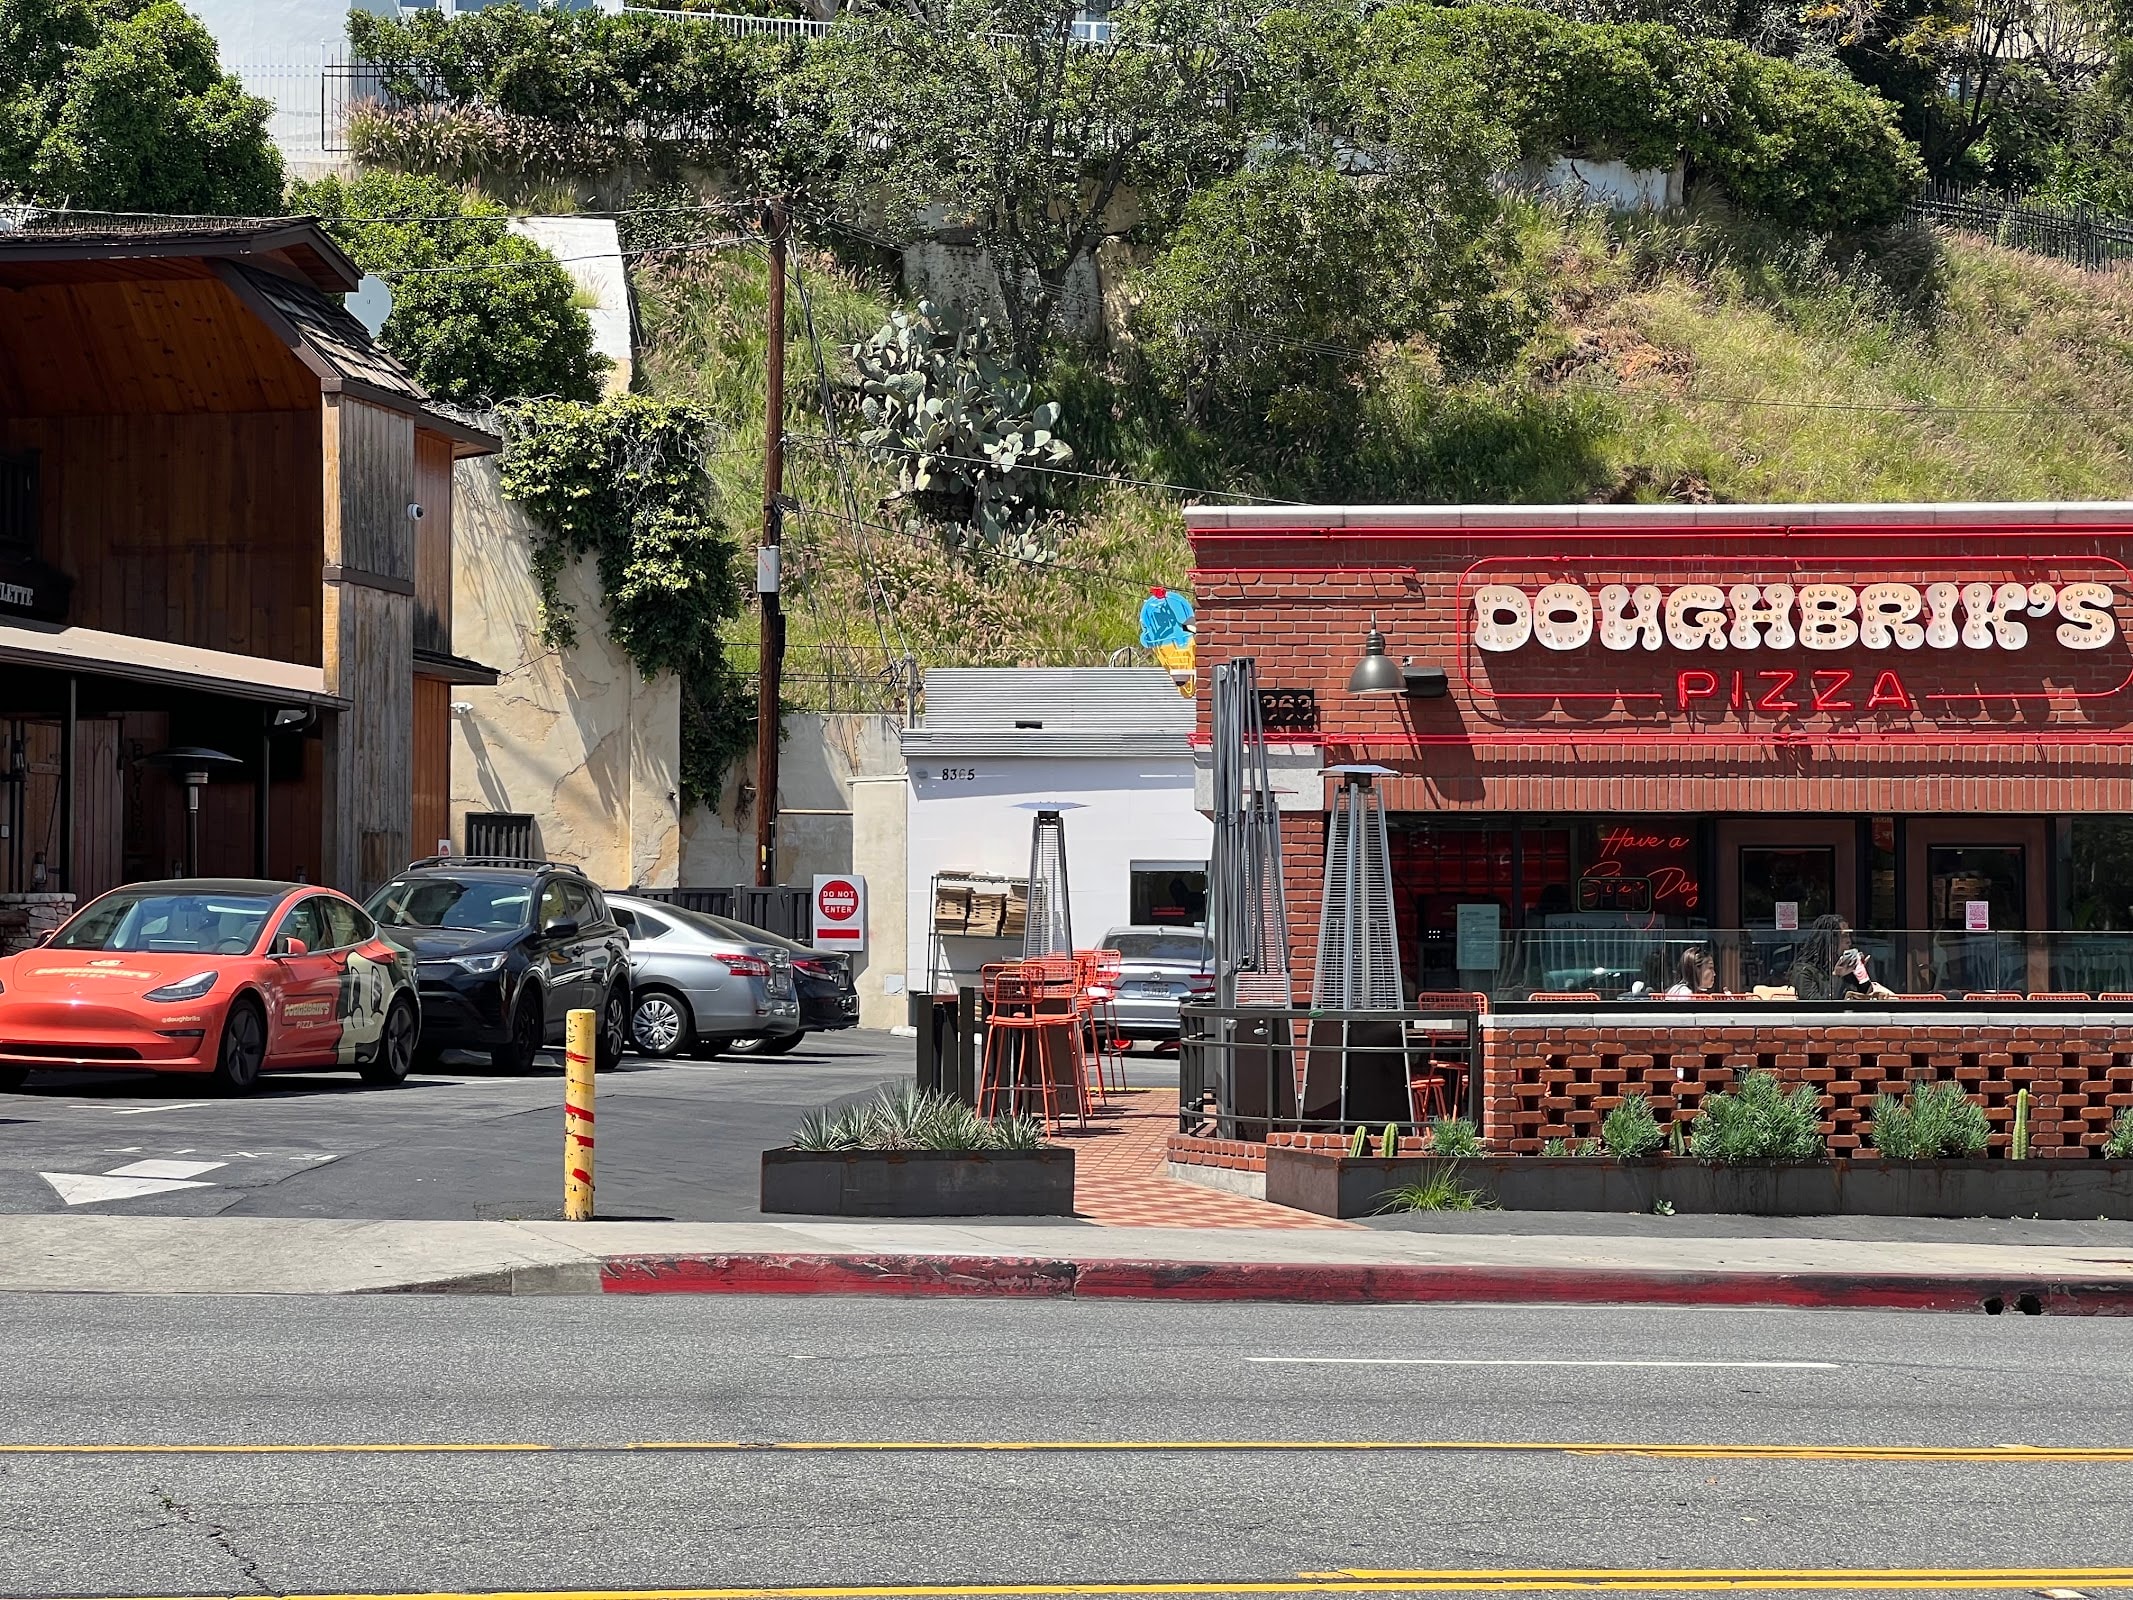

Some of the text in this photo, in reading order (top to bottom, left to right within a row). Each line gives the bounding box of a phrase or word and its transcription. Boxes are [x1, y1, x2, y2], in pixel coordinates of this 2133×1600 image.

[0, 582, 33, 606] LETTE
[1475, 583, 2115, 651] DOUGHBRIK'S
[1676, 669, 1914, 711] PIZZA
[942, 768, 975, 781] 8365
[1600, 827, 1690, 858] Have a
[823, 890, 855, 898] DO NOT
[1646, 867, 1698, 908] Day
[825, 905, 852, 913] ENTER
[296, 1020, 313, 1029] PIZZA
